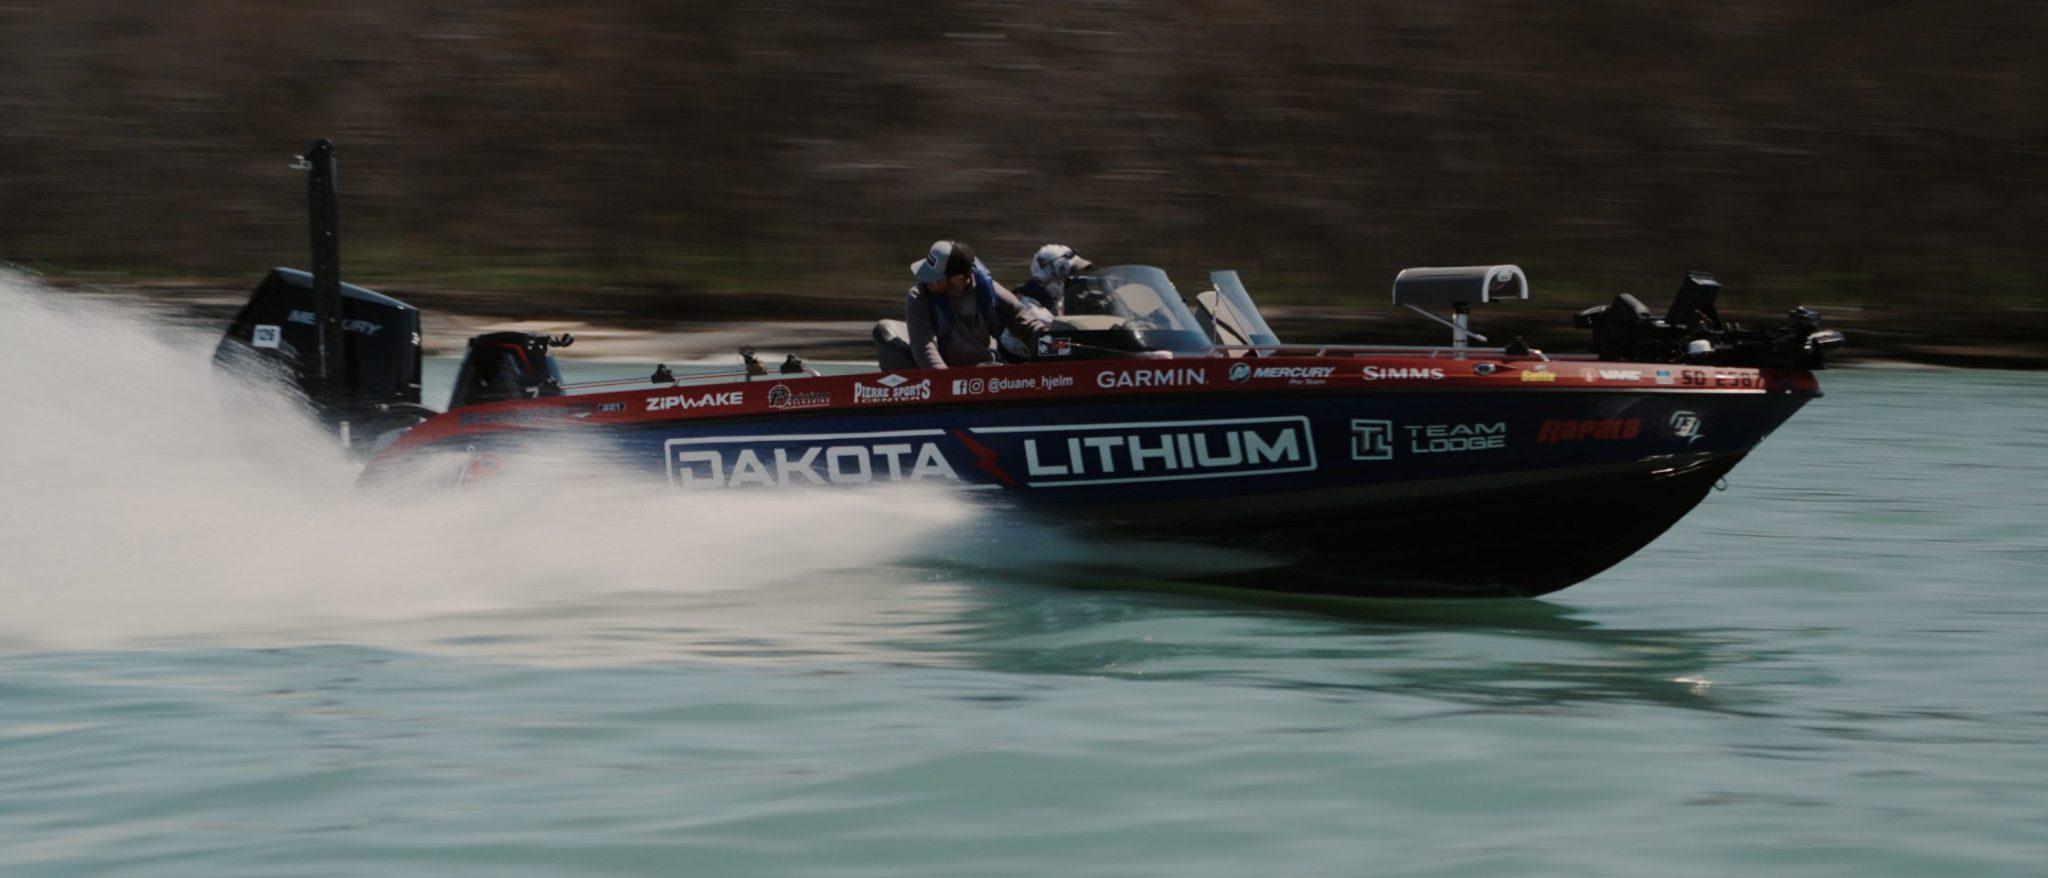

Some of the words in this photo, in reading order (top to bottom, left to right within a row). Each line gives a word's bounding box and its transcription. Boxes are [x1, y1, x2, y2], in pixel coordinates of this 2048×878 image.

[287, 310, 382, 335] MEURY
[1097, 368, 1205, 388] GARMIN
[1253, 366, 1336, 378] MERCURY
[1362, 365, 1445, 380] SIMMS
[853, 382, 889, 403] PIERRE
[892, 378, 931, 399] SPORTS
[988, 374, 1073, 392] @duane_hjelm
[1403, 422, 1506, 438] TEAM
[1411, 435, 1506, 453] LODGE
[679, 442, 959, 488] DAKOTA
[1024, 428, 1300, 476] LITHIUM
